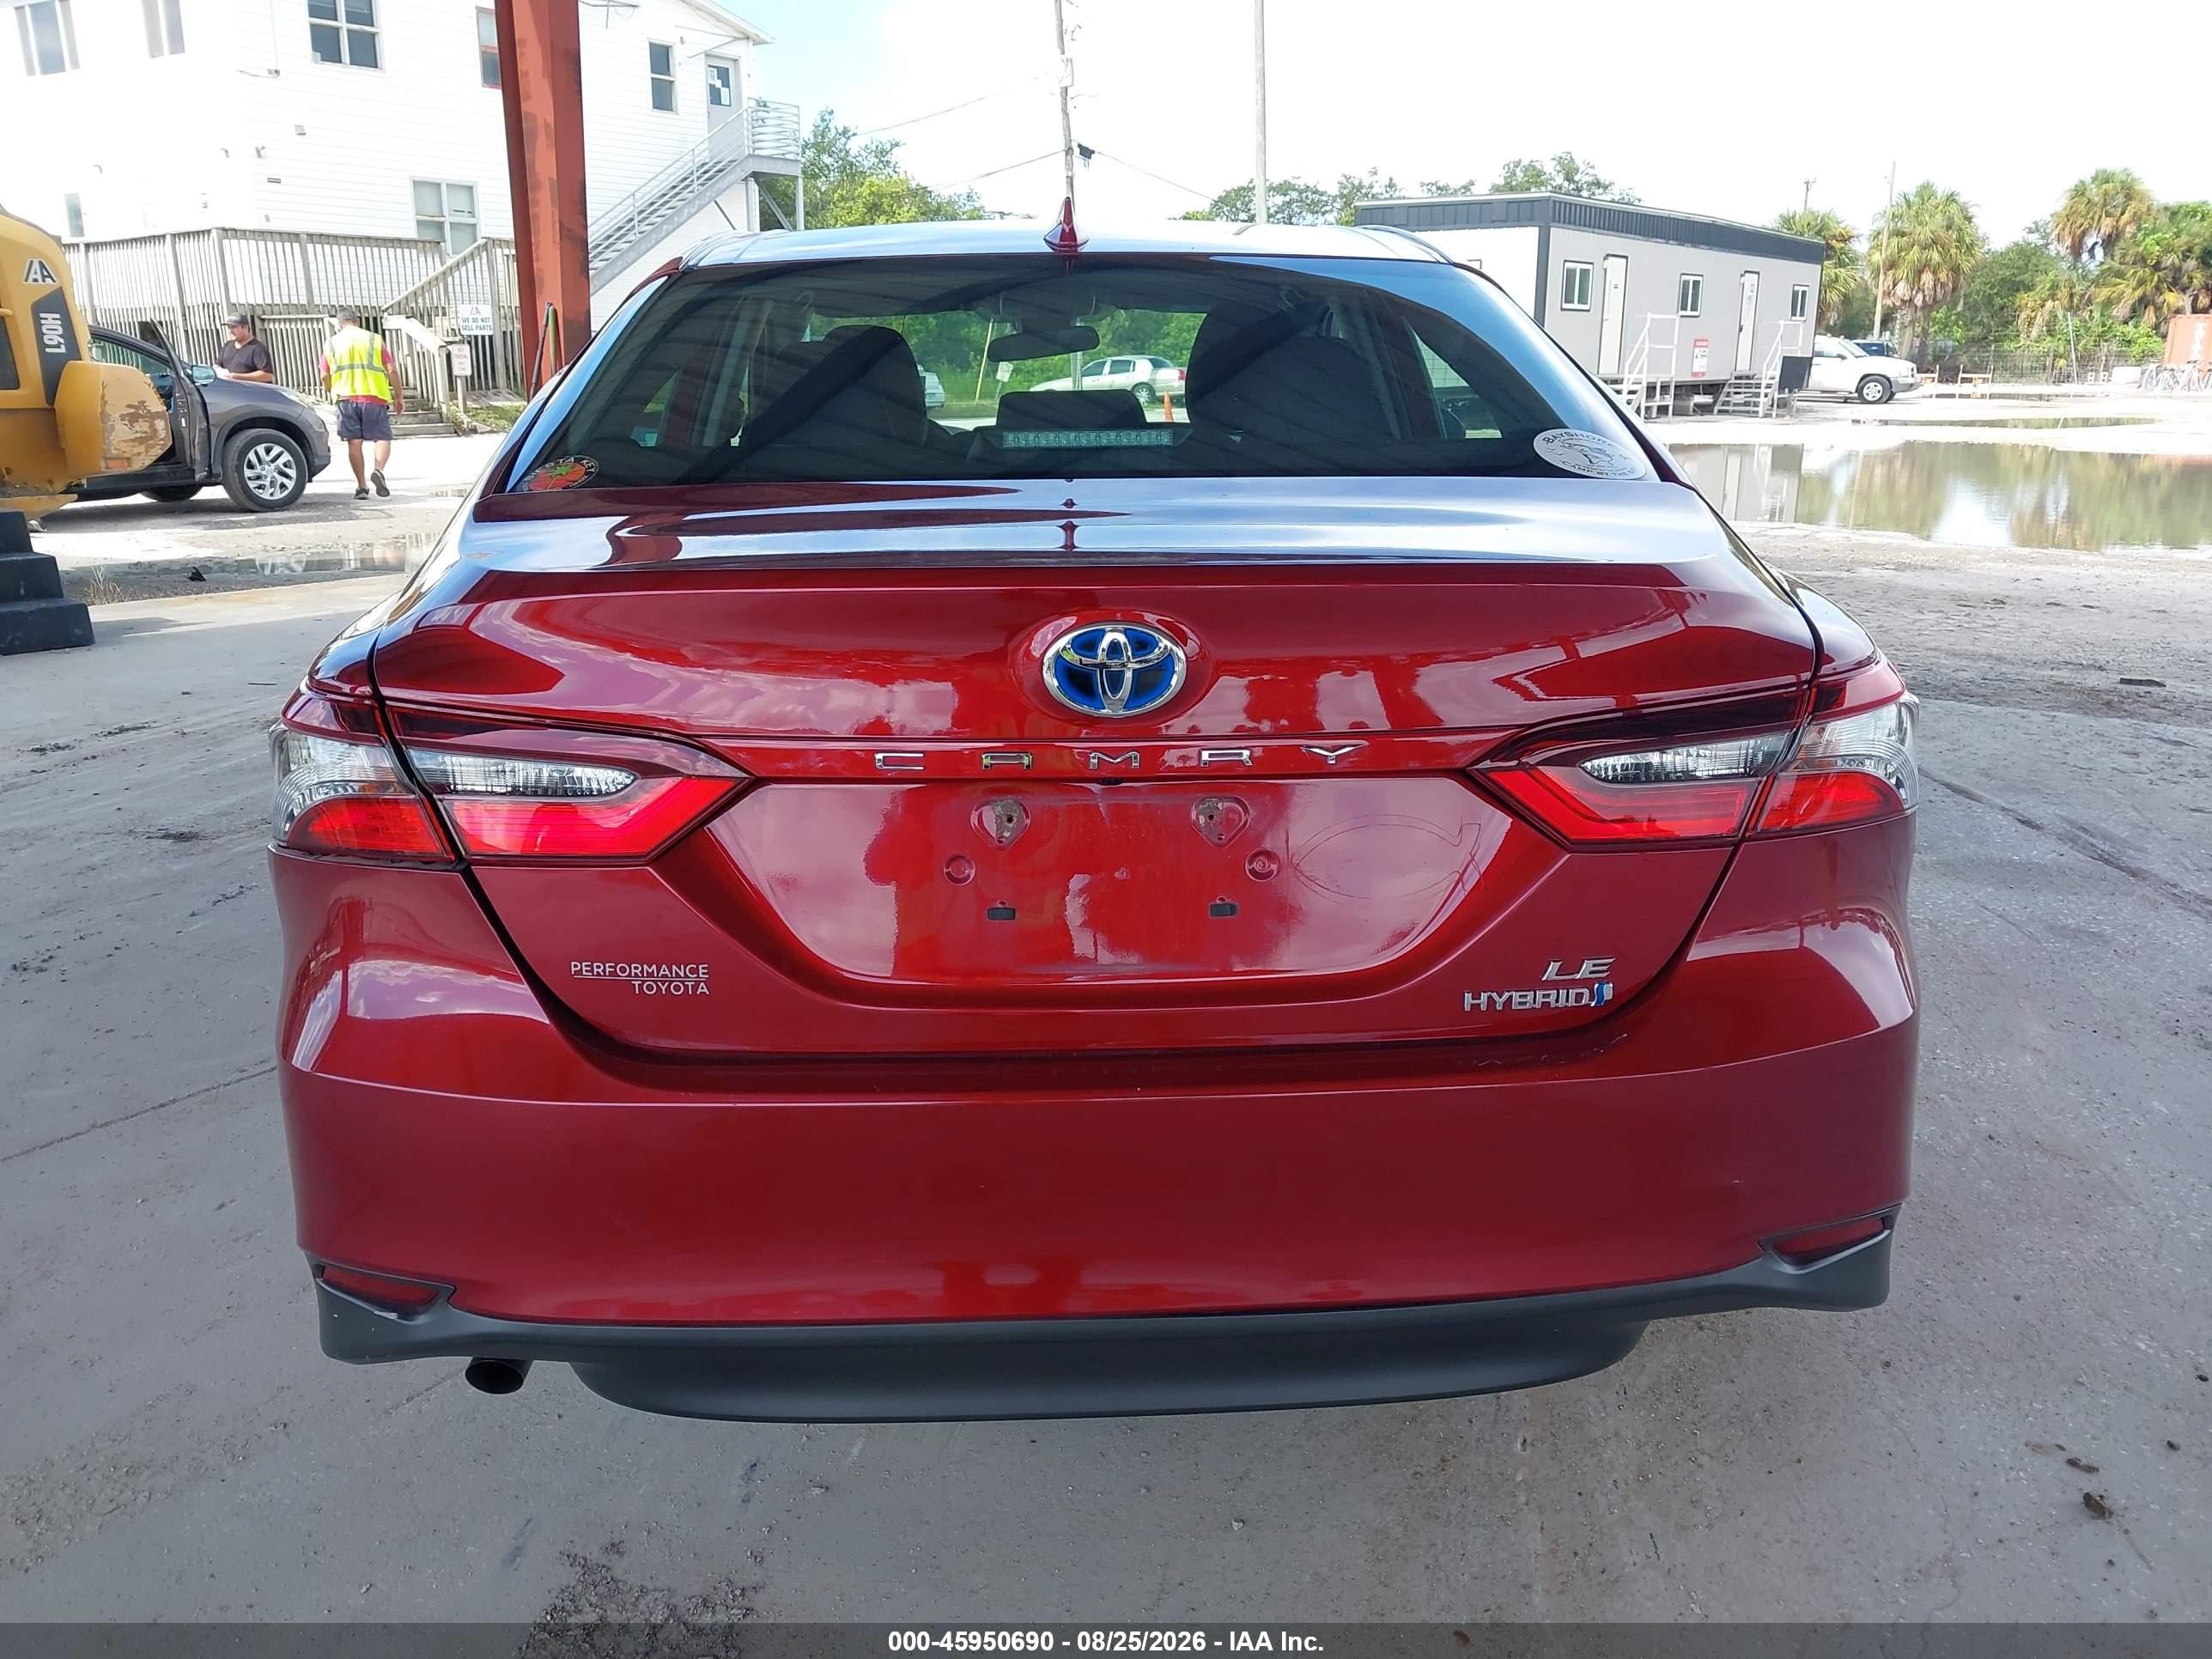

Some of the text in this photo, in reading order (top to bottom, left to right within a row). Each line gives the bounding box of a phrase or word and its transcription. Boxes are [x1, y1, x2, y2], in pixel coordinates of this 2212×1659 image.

[40, 313, 66, 354] L90H
[580, 459, 596, 473] KEY
[874, 744, 1364, 770] CAMRY
[570, 962, 709, 978] PERFORMANCE
[1541, 957, 1616, 981] LE
[631, 981, 709, 995] TOYOTA
[1464, 988, 1590, 1012] HYBRID
